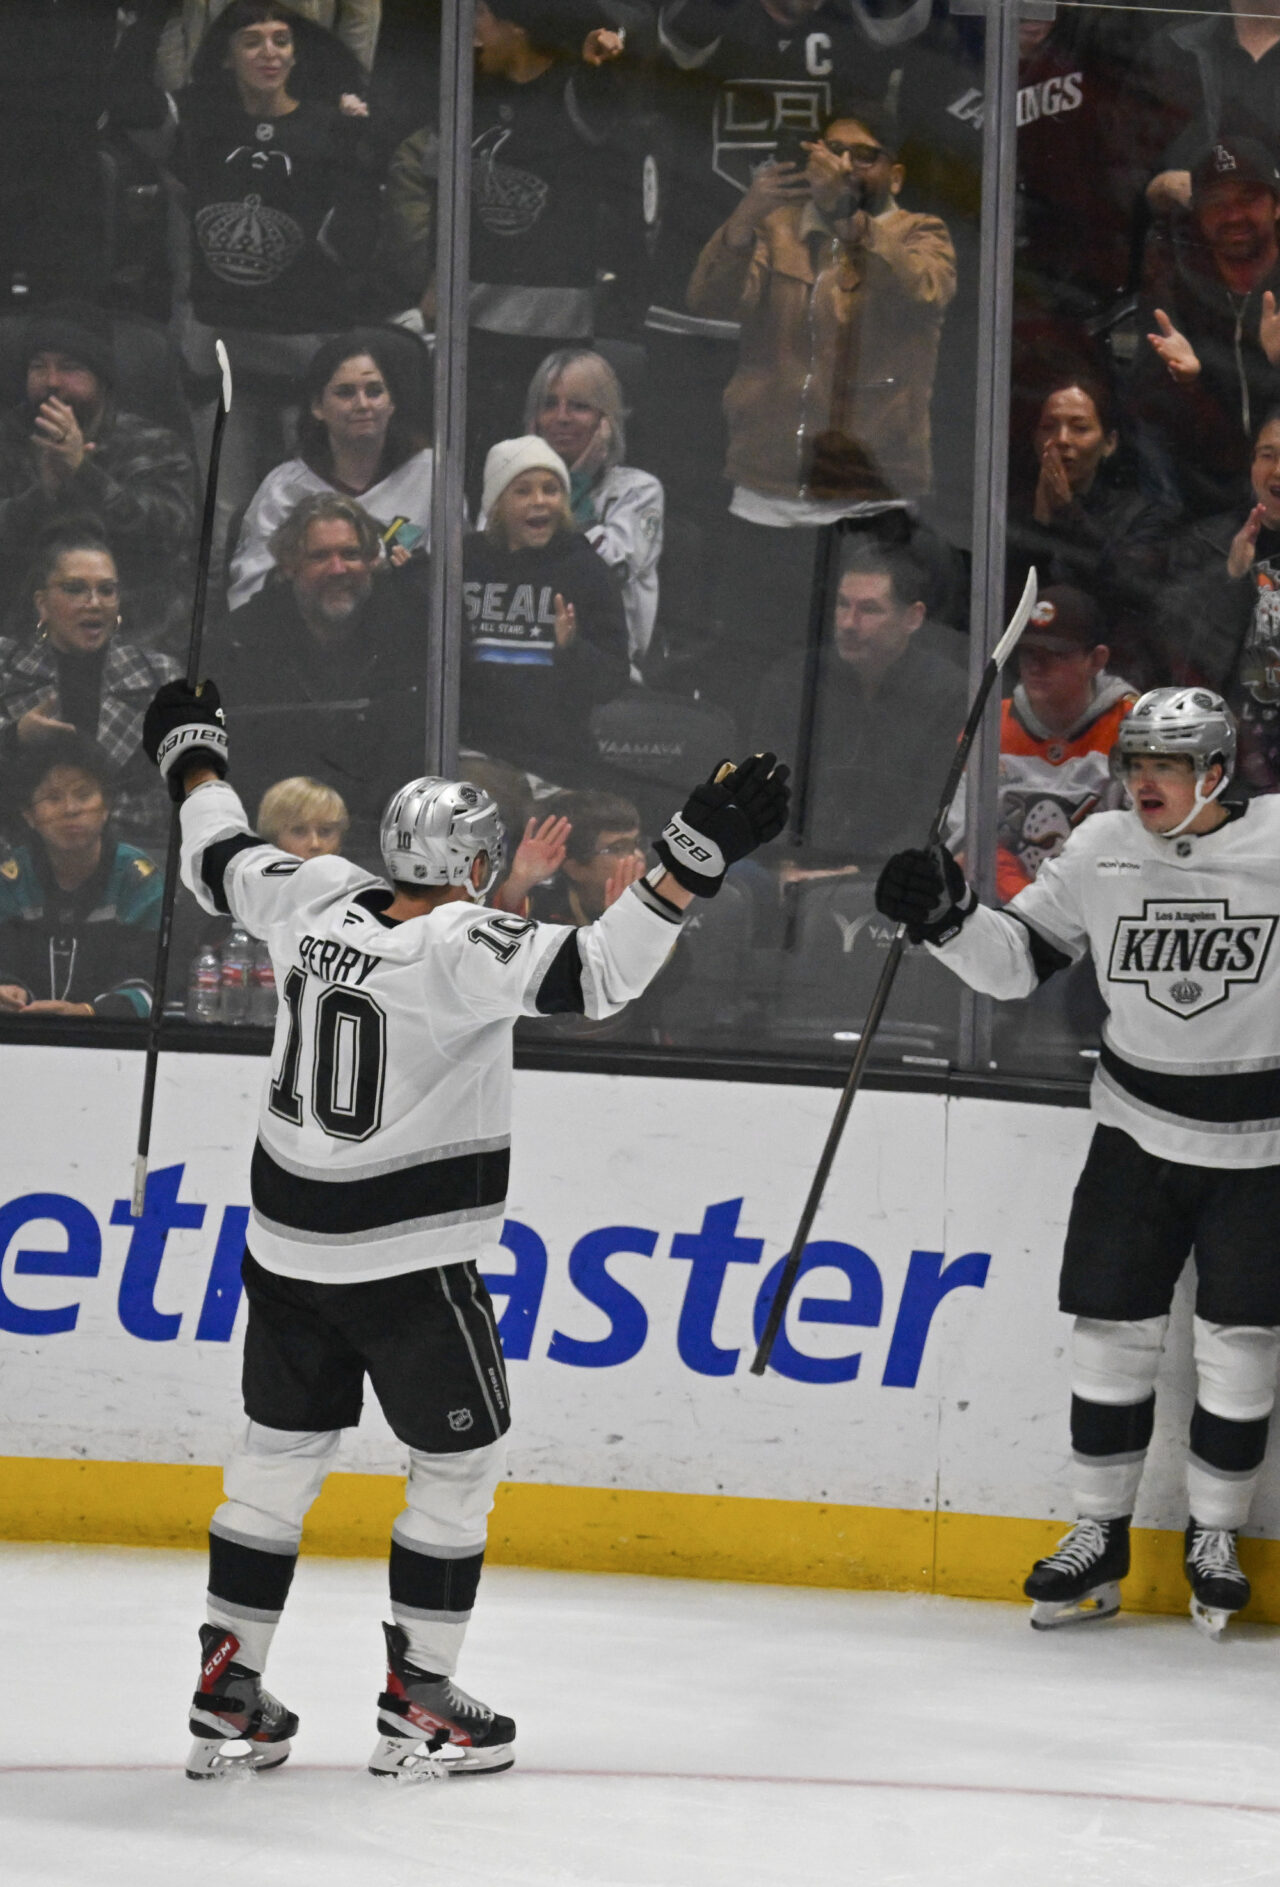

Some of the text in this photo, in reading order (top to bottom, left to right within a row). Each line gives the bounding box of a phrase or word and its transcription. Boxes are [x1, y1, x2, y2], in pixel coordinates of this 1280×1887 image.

[806, 32, 832, 75] C
[724, 91, 821, 132] LA
[1155, 911, 1217, 923] Los Angeles
[299, 935, 383, 986] PERRY
[467, 917, 538, 965] 10
[1119, 927, 1261, 973] KINGS
[268, 965, 387, 1142] 10
[204, 1641, 231, 1676] CCM
